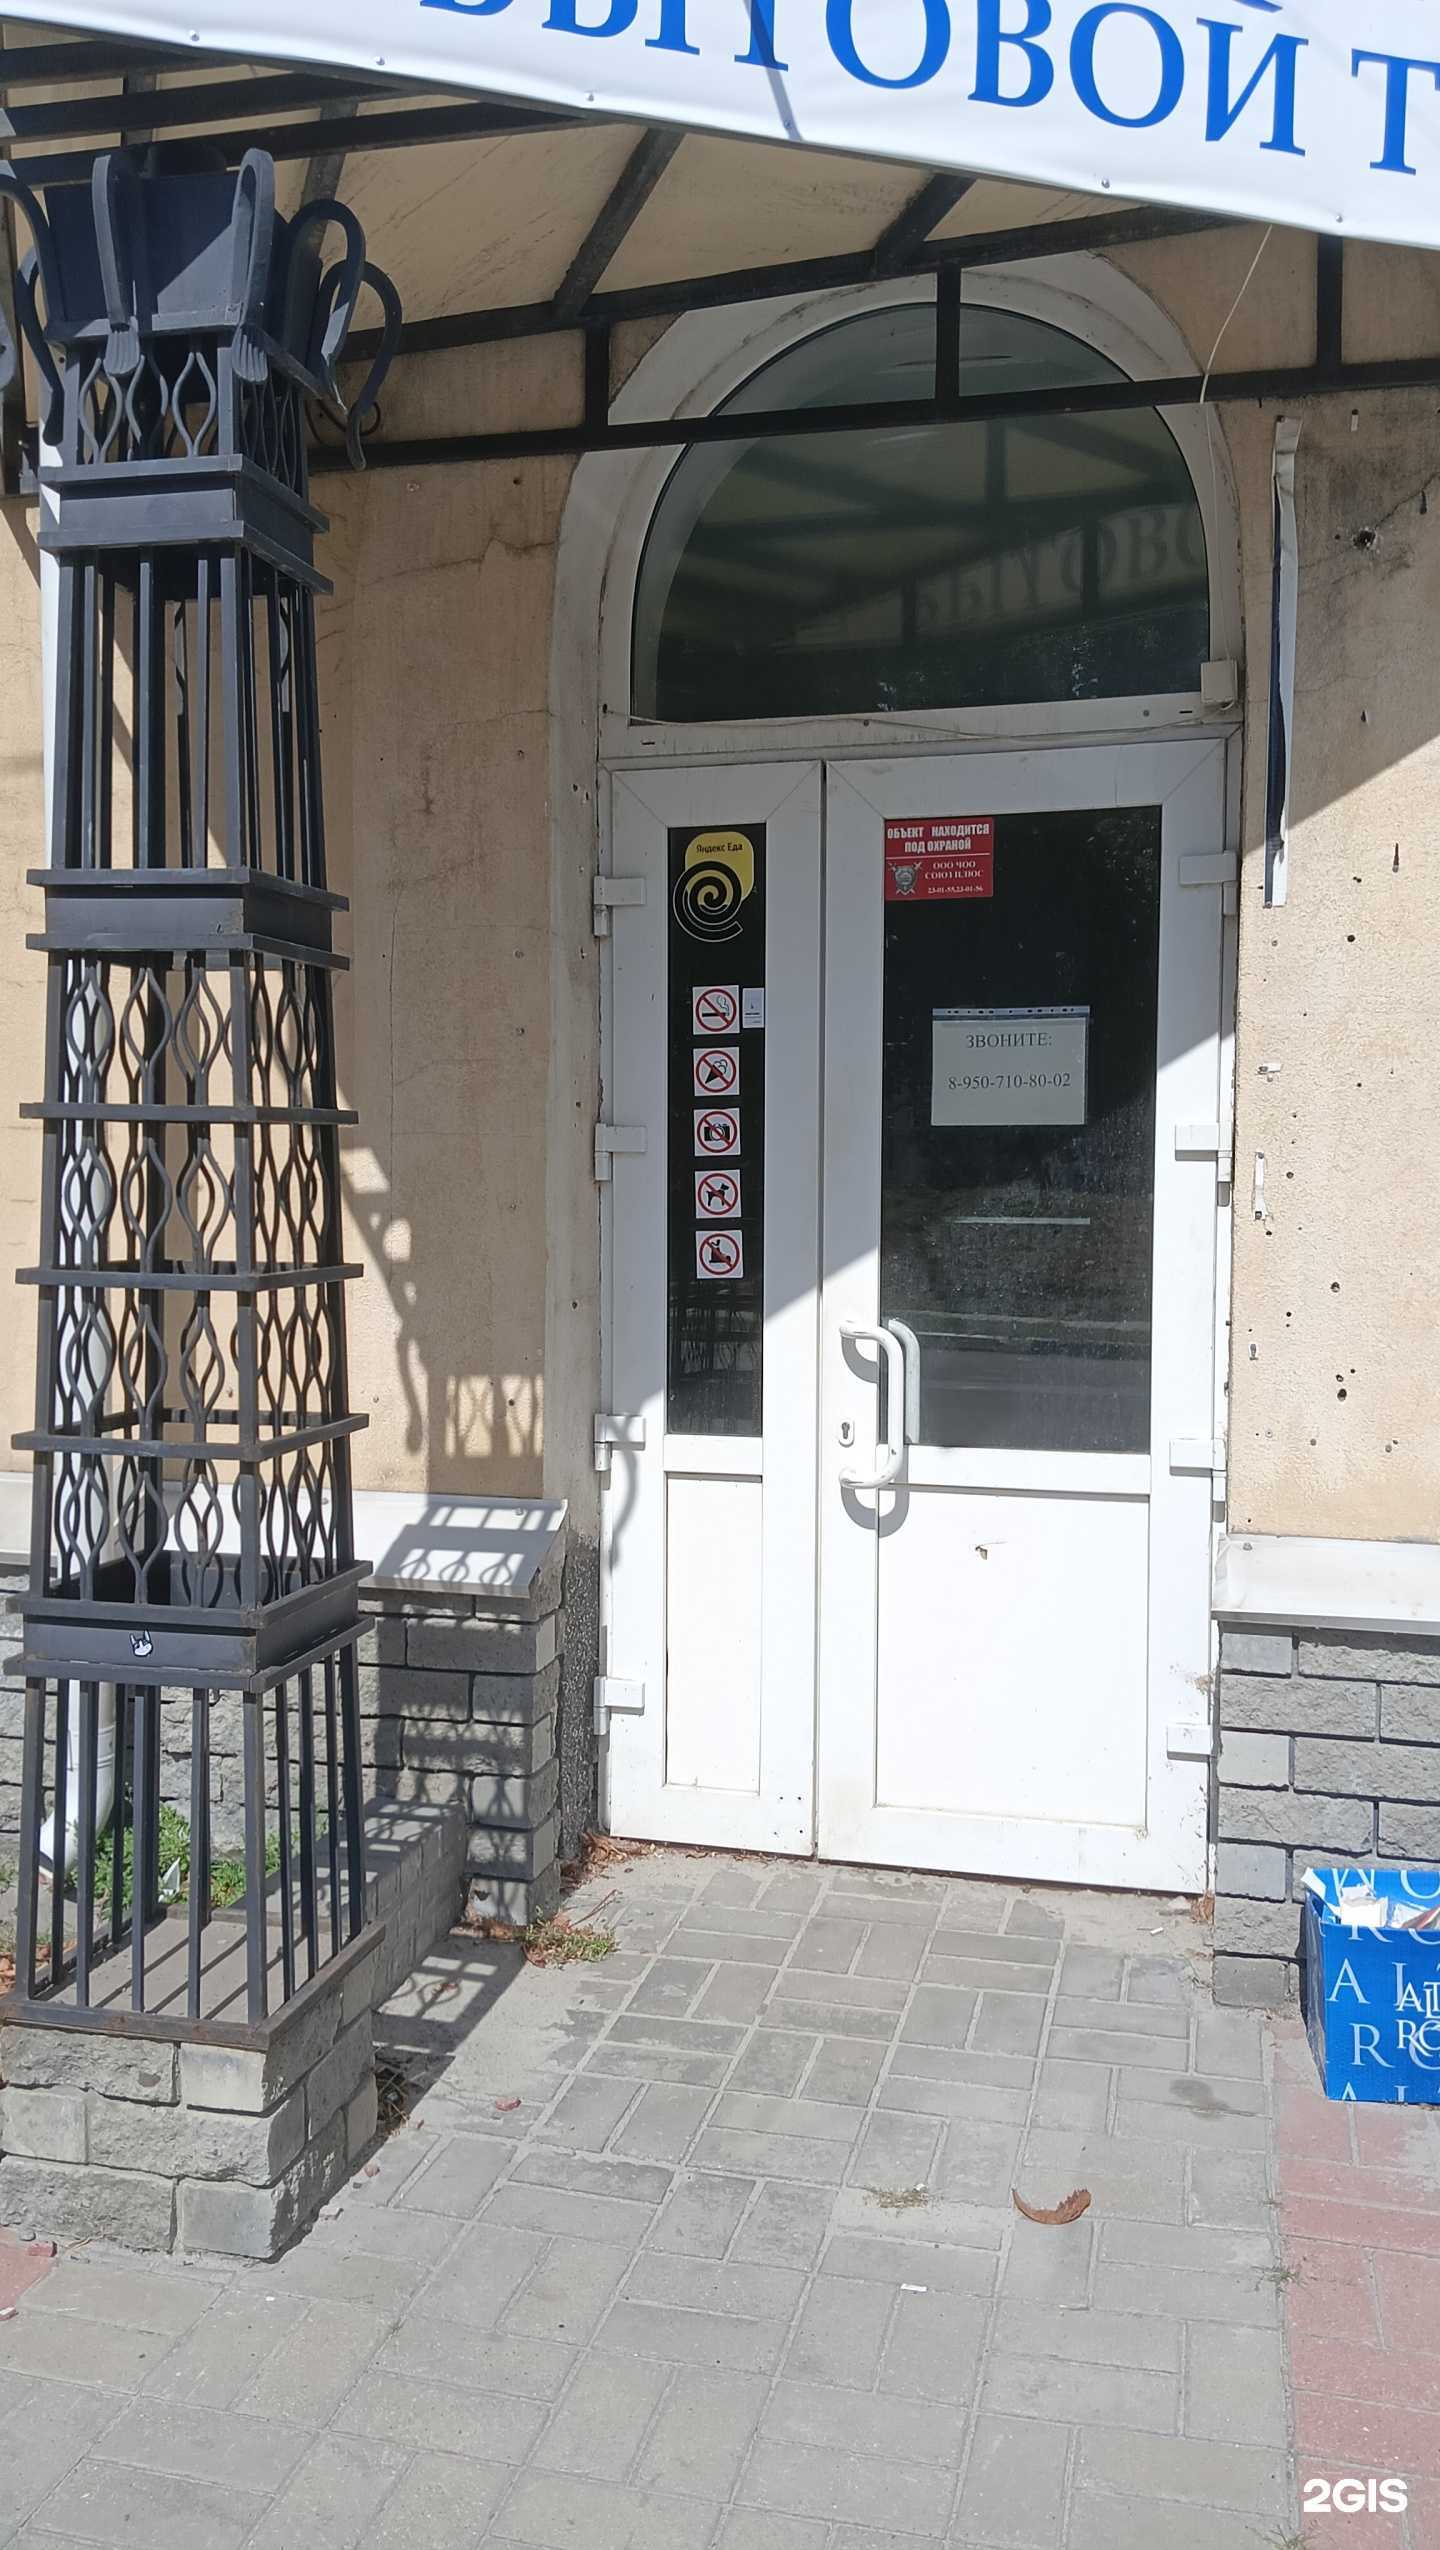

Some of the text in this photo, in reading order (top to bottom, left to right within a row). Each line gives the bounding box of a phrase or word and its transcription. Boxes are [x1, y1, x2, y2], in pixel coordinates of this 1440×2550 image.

[420, 0, 1309, 157] ОВОЙ
[887, 824, 990, 839] ОБЪЕКТ НАХОДИТСЯ
[696, 842, 743, 854] Яндекс Еда
[904, 837, 972, 854] ПОД ОХРАНОЙ
[932, 860, 976, 870] ООО ЧОО
[966, 1032, 1053, 1049] ЗВОНИТЕ:
[948, 1073, 1071, 1089] 8-950-710-80-02
